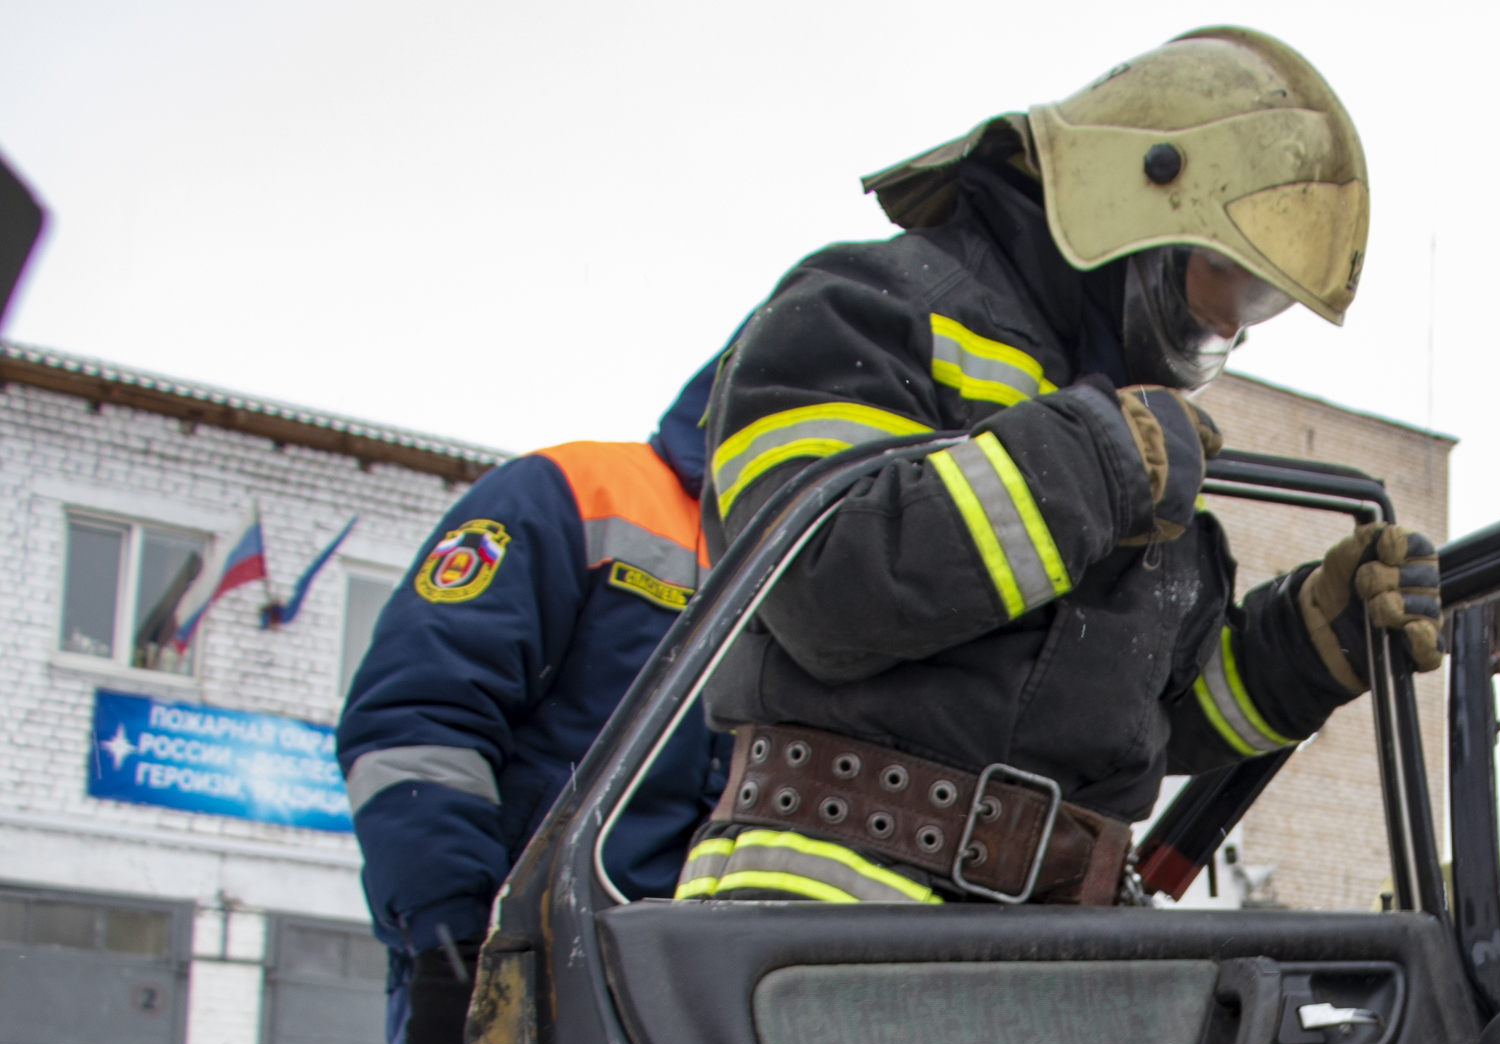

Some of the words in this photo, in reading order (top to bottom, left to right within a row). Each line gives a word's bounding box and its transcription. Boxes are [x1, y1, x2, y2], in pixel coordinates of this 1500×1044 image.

[150, 705, 276, 744] ПОЖАРНАЯ
[280, 727, 335, 754] ОХРА
[138, 732, 231, 765] РОССИИ
[251, 751, 341, 784] ДОБЛЕС
